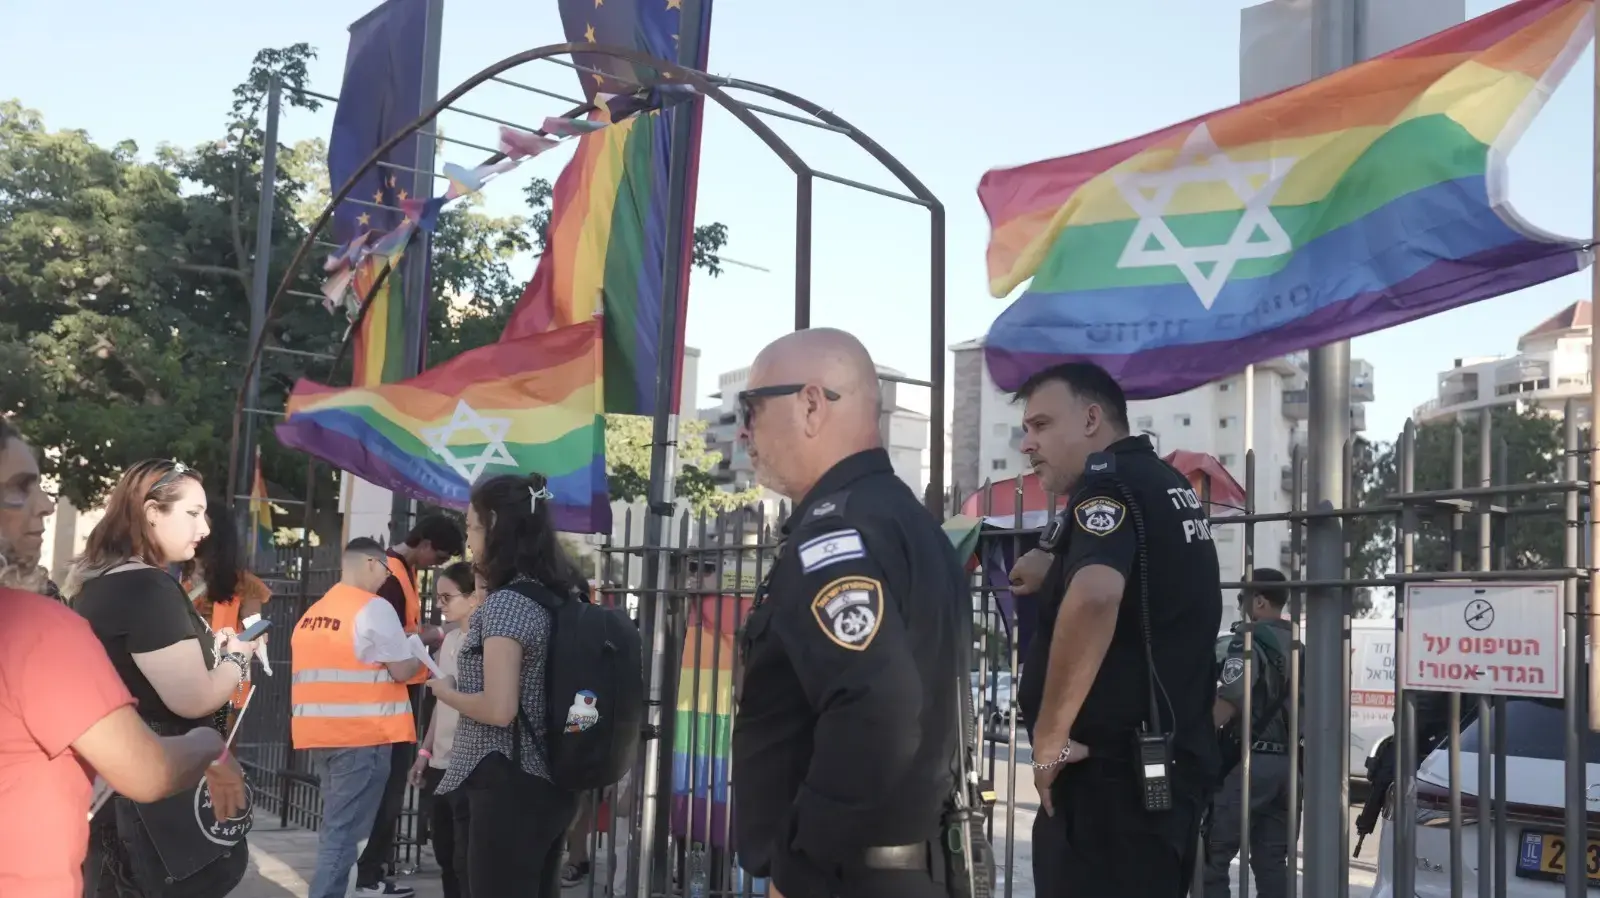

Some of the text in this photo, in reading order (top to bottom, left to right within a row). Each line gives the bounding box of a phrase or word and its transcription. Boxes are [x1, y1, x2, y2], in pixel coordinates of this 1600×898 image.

[1373, 643, 1391, 654] דוד
[1423, 633, 1540, 656] הטיפוס על
[1366, 667, 1396, 680] שראל
[1419, 660, 1545, 684] הגדר אסור!
